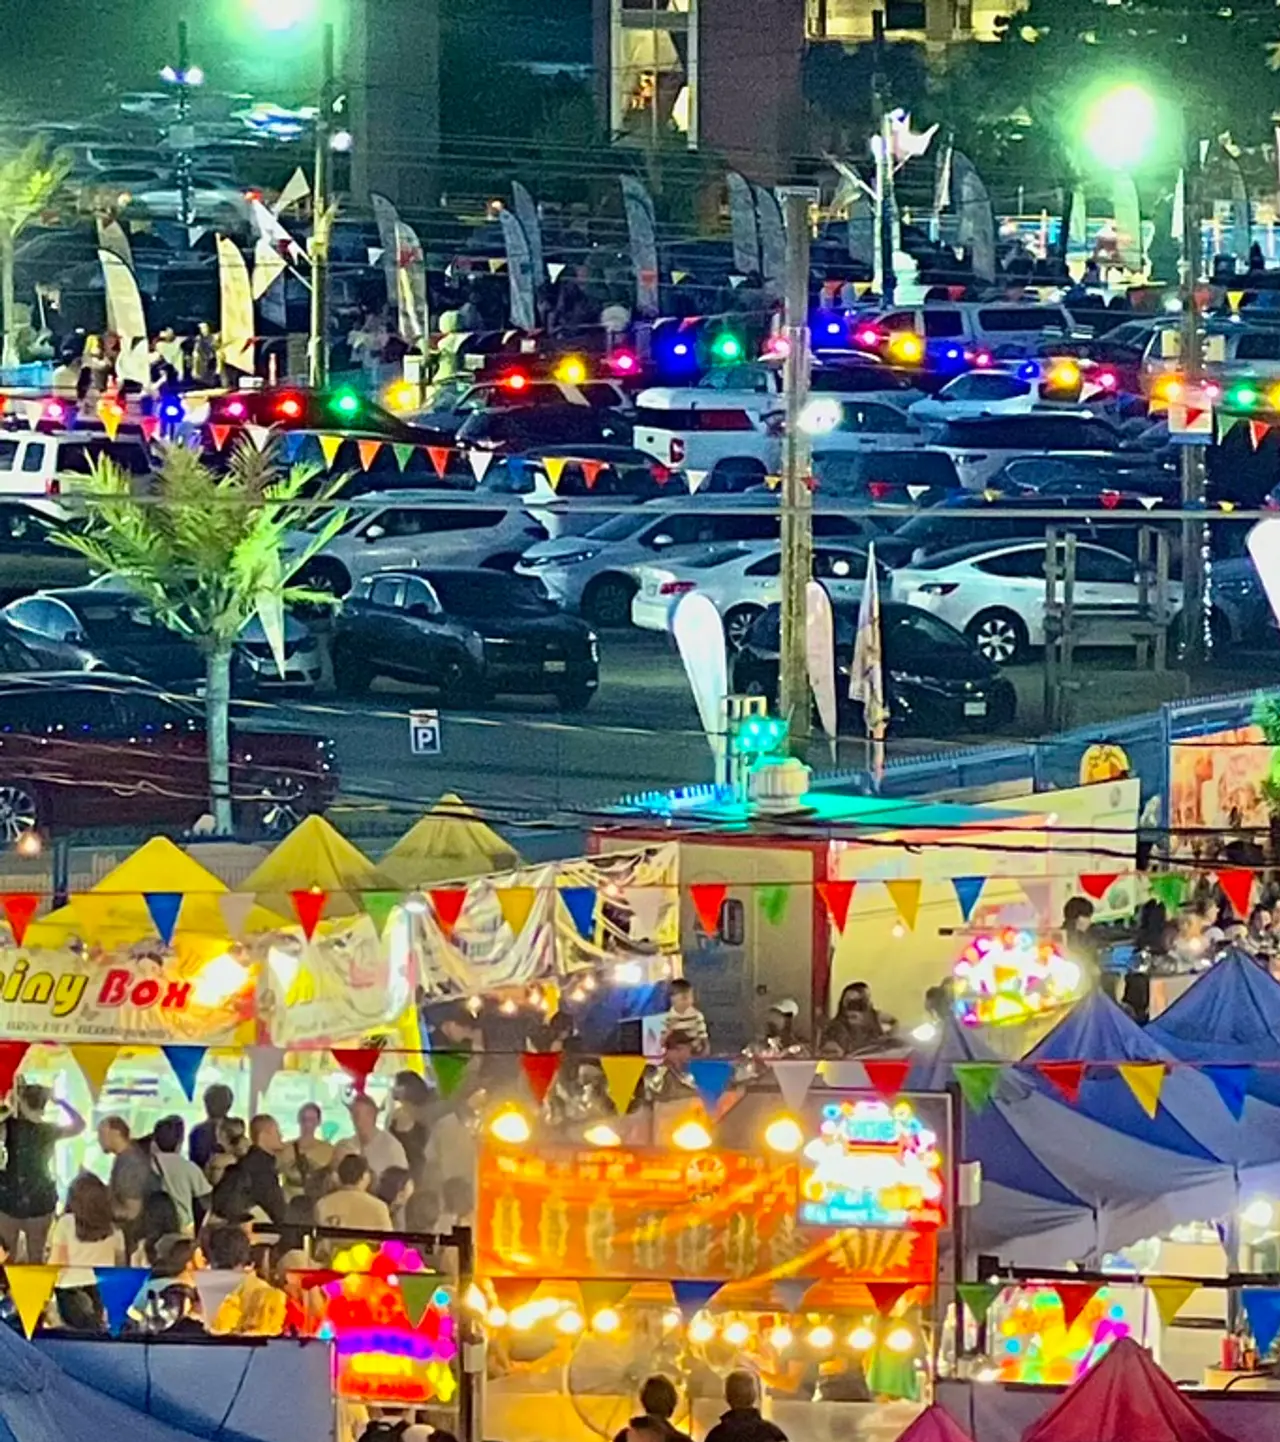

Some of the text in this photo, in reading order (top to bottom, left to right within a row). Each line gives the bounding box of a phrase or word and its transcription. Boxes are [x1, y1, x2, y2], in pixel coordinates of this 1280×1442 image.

[417, 729, 433, 749] P
[0, 960, 192, 1016] iny Box
